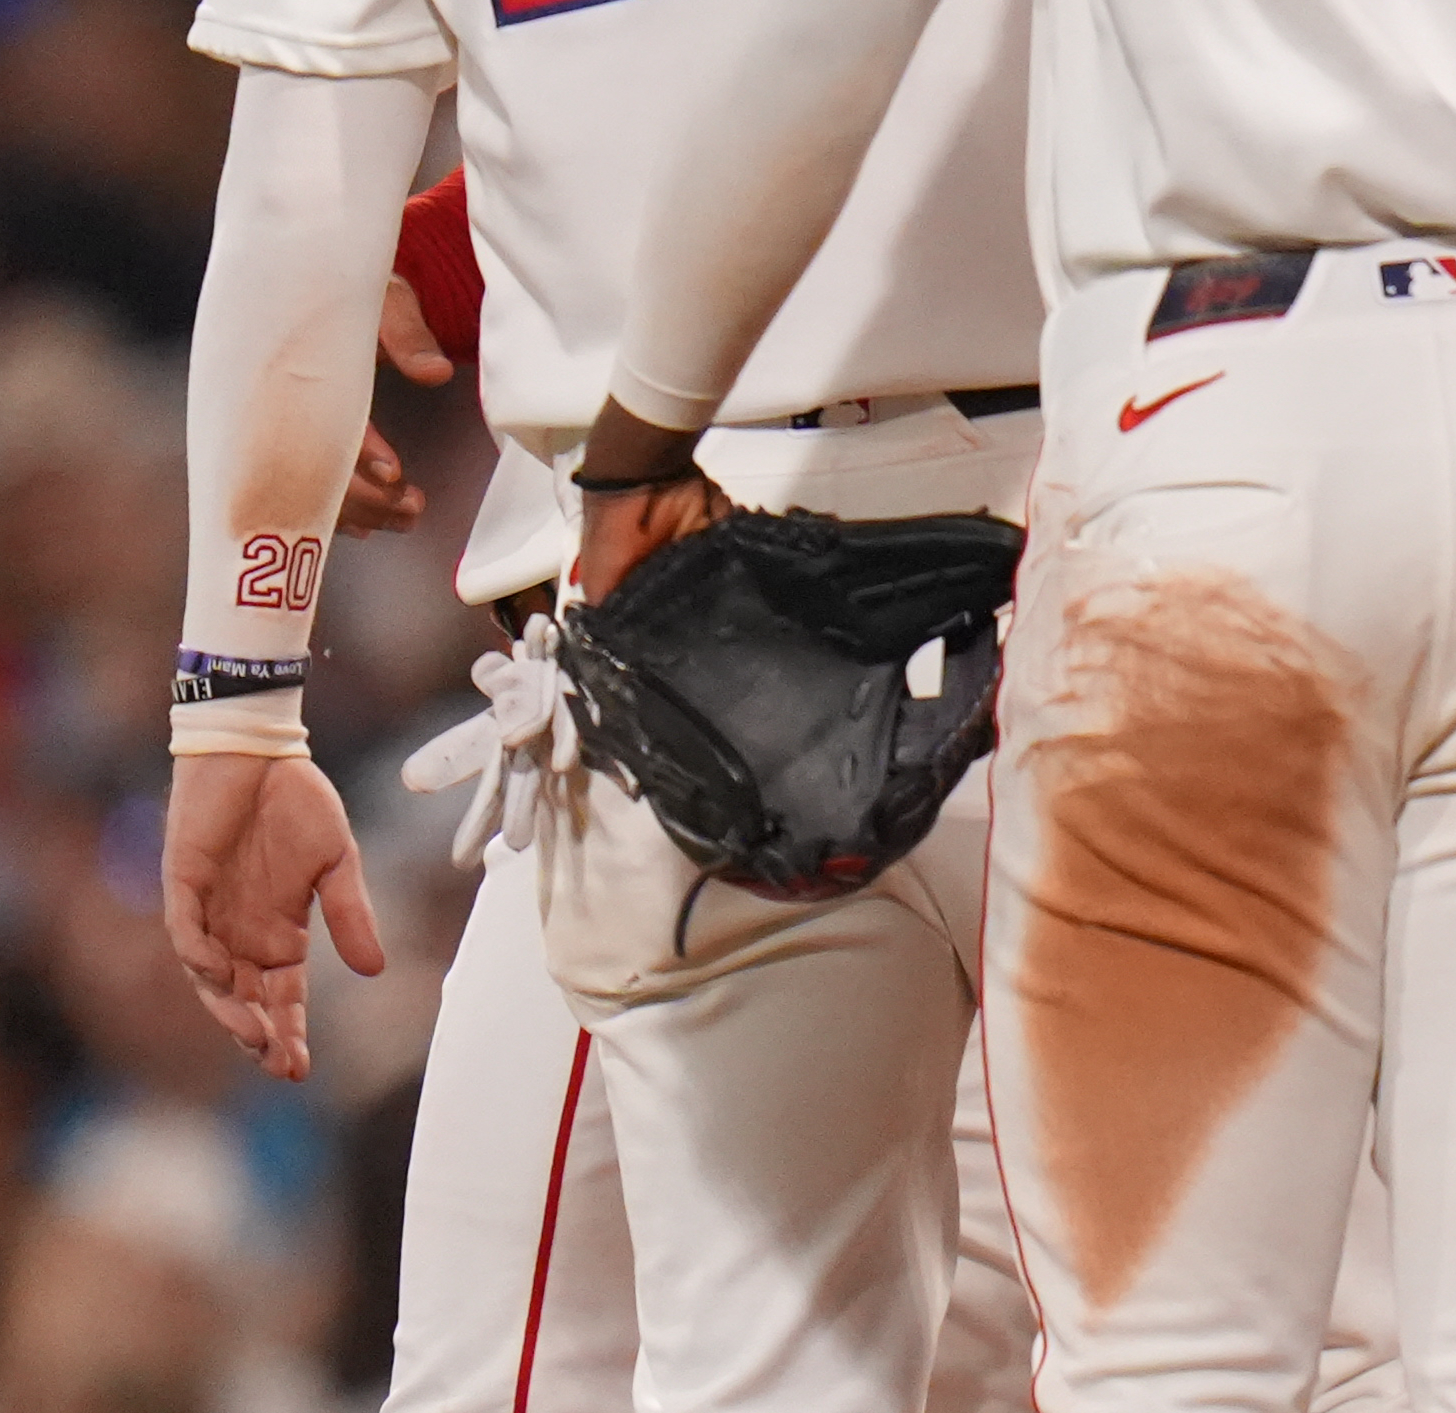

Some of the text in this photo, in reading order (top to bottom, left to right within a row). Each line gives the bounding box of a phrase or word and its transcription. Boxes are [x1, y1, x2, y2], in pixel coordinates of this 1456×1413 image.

[236, 533, 323, 611] 20
[207, 657, 303, 679] Love Ya Man!
